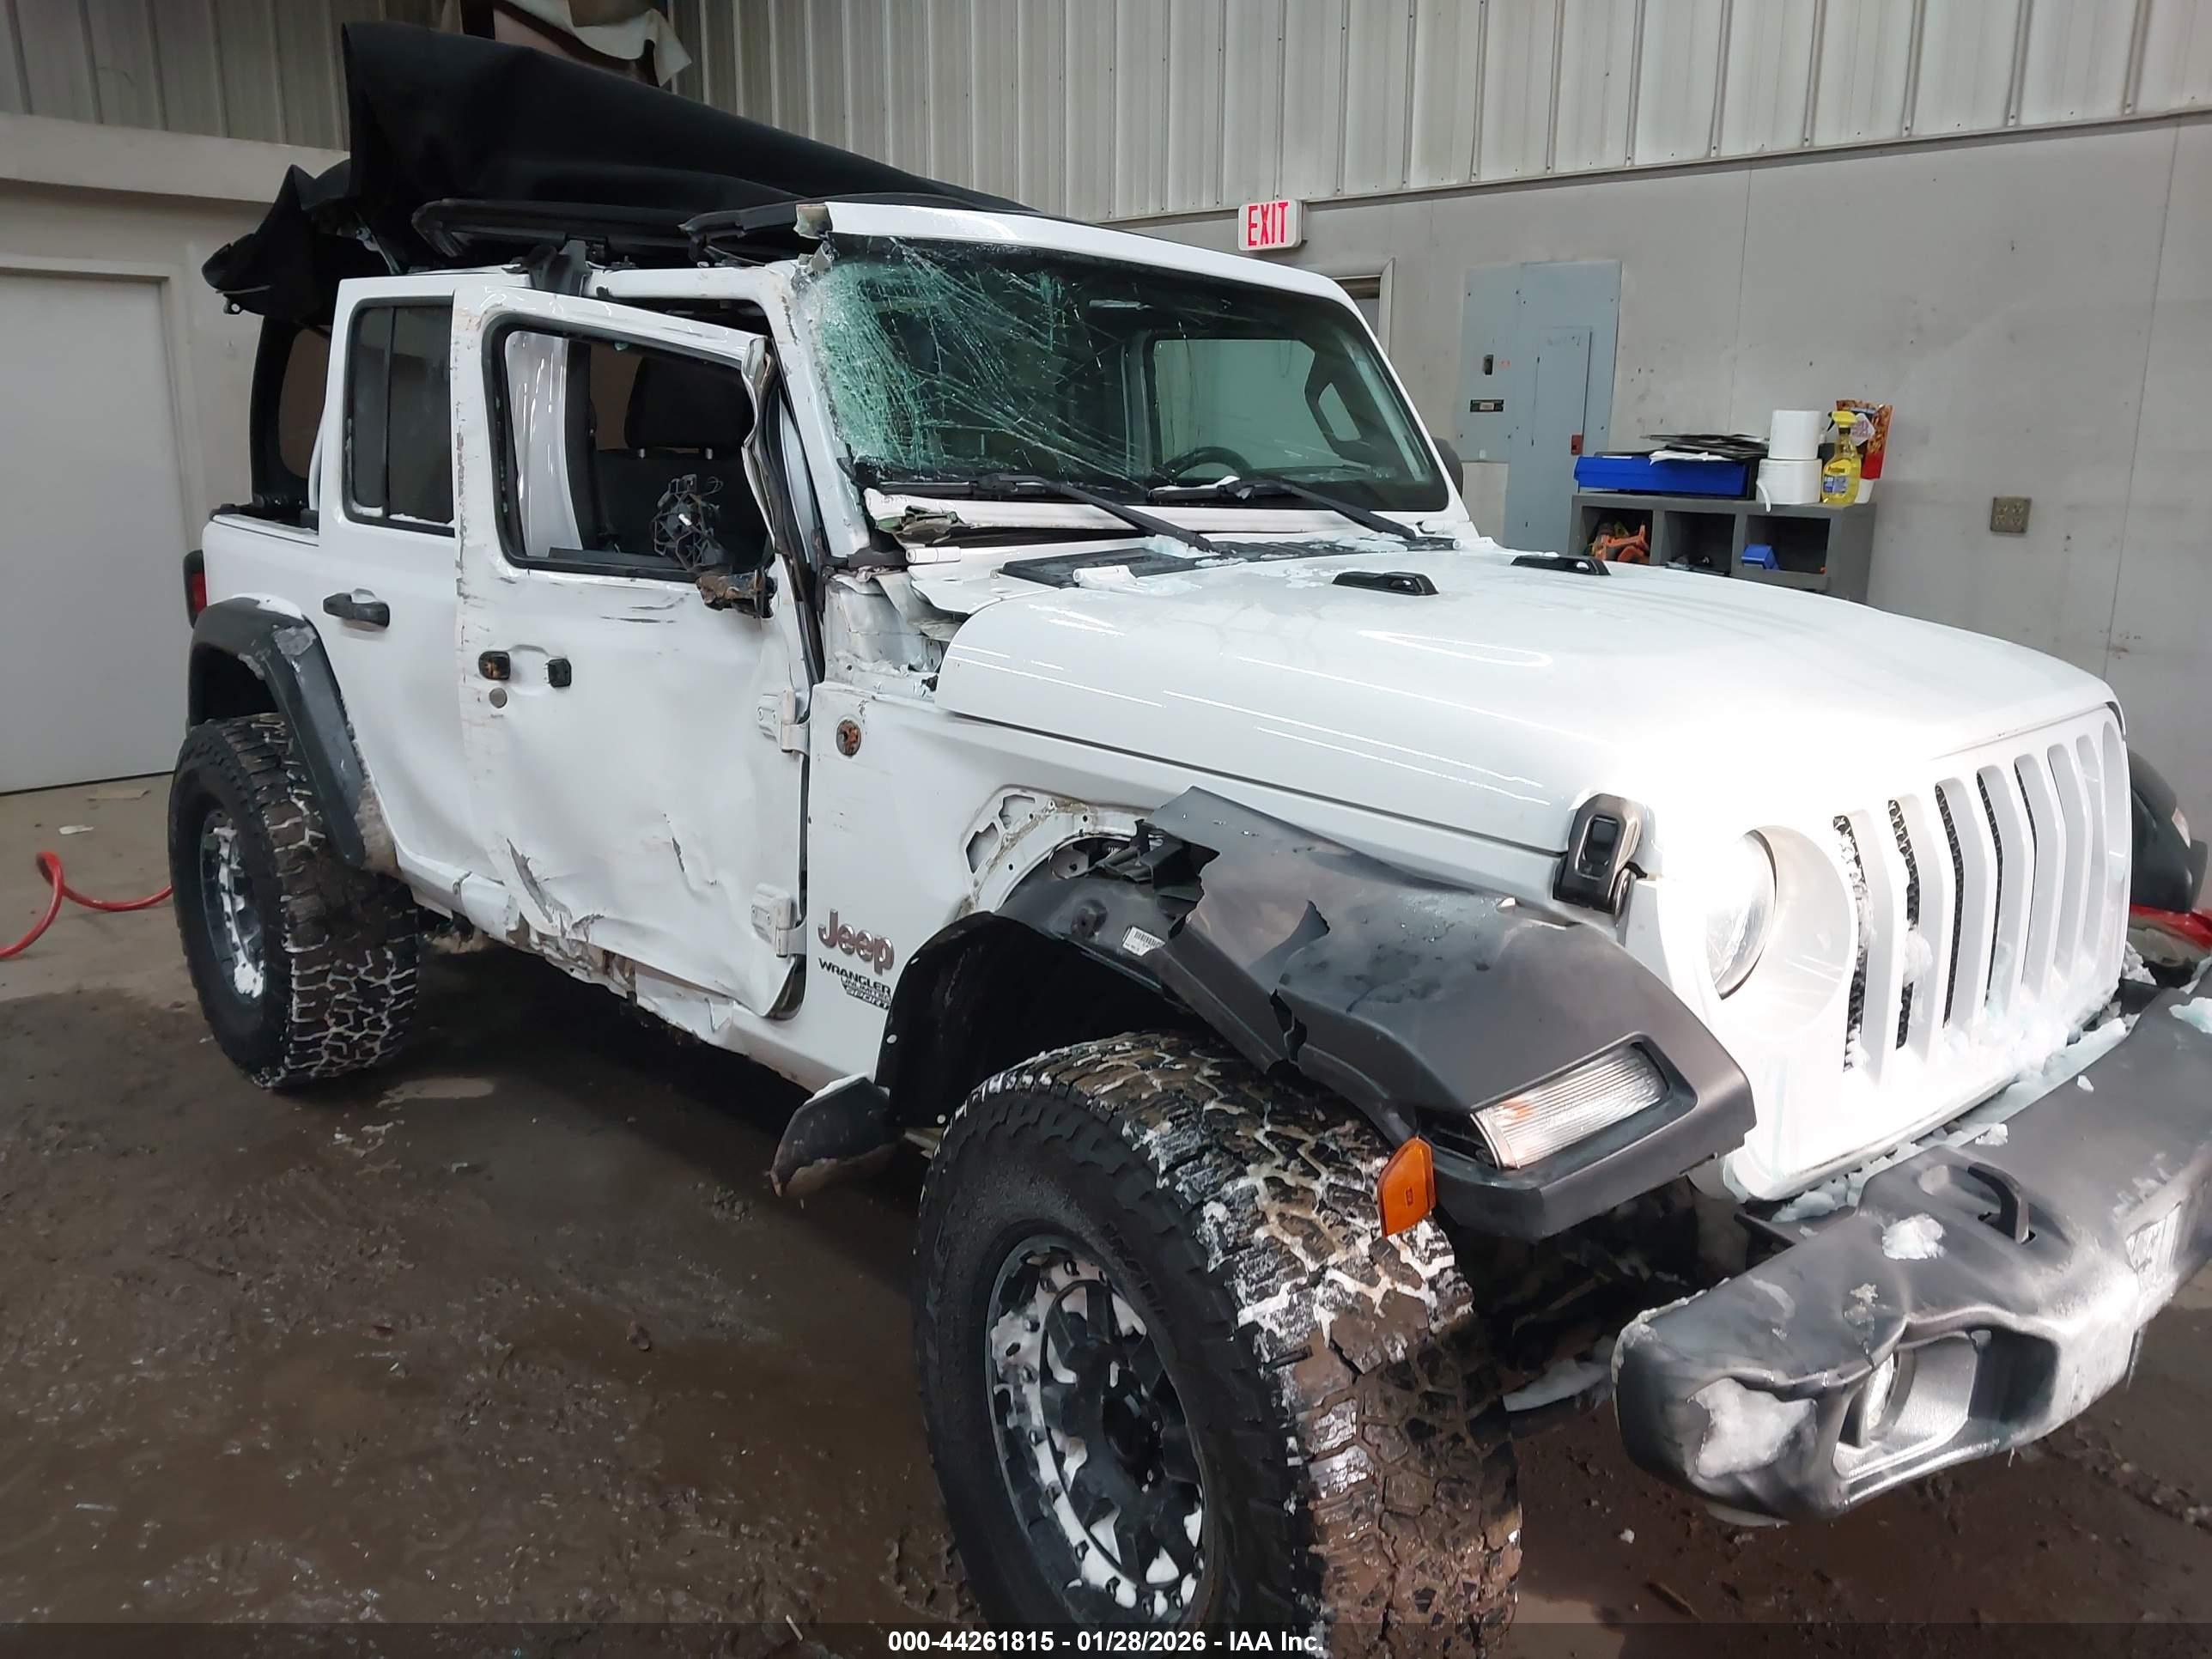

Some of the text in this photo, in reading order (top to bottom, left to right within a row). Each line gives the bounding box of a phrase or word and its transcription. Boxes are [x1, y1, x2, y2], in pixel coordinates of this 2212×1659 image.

[1248, 202, 1288, 246] EXIT
[817, 908, 895, 975] Jeep
[818, 957, 891, 995] WRANGLER
